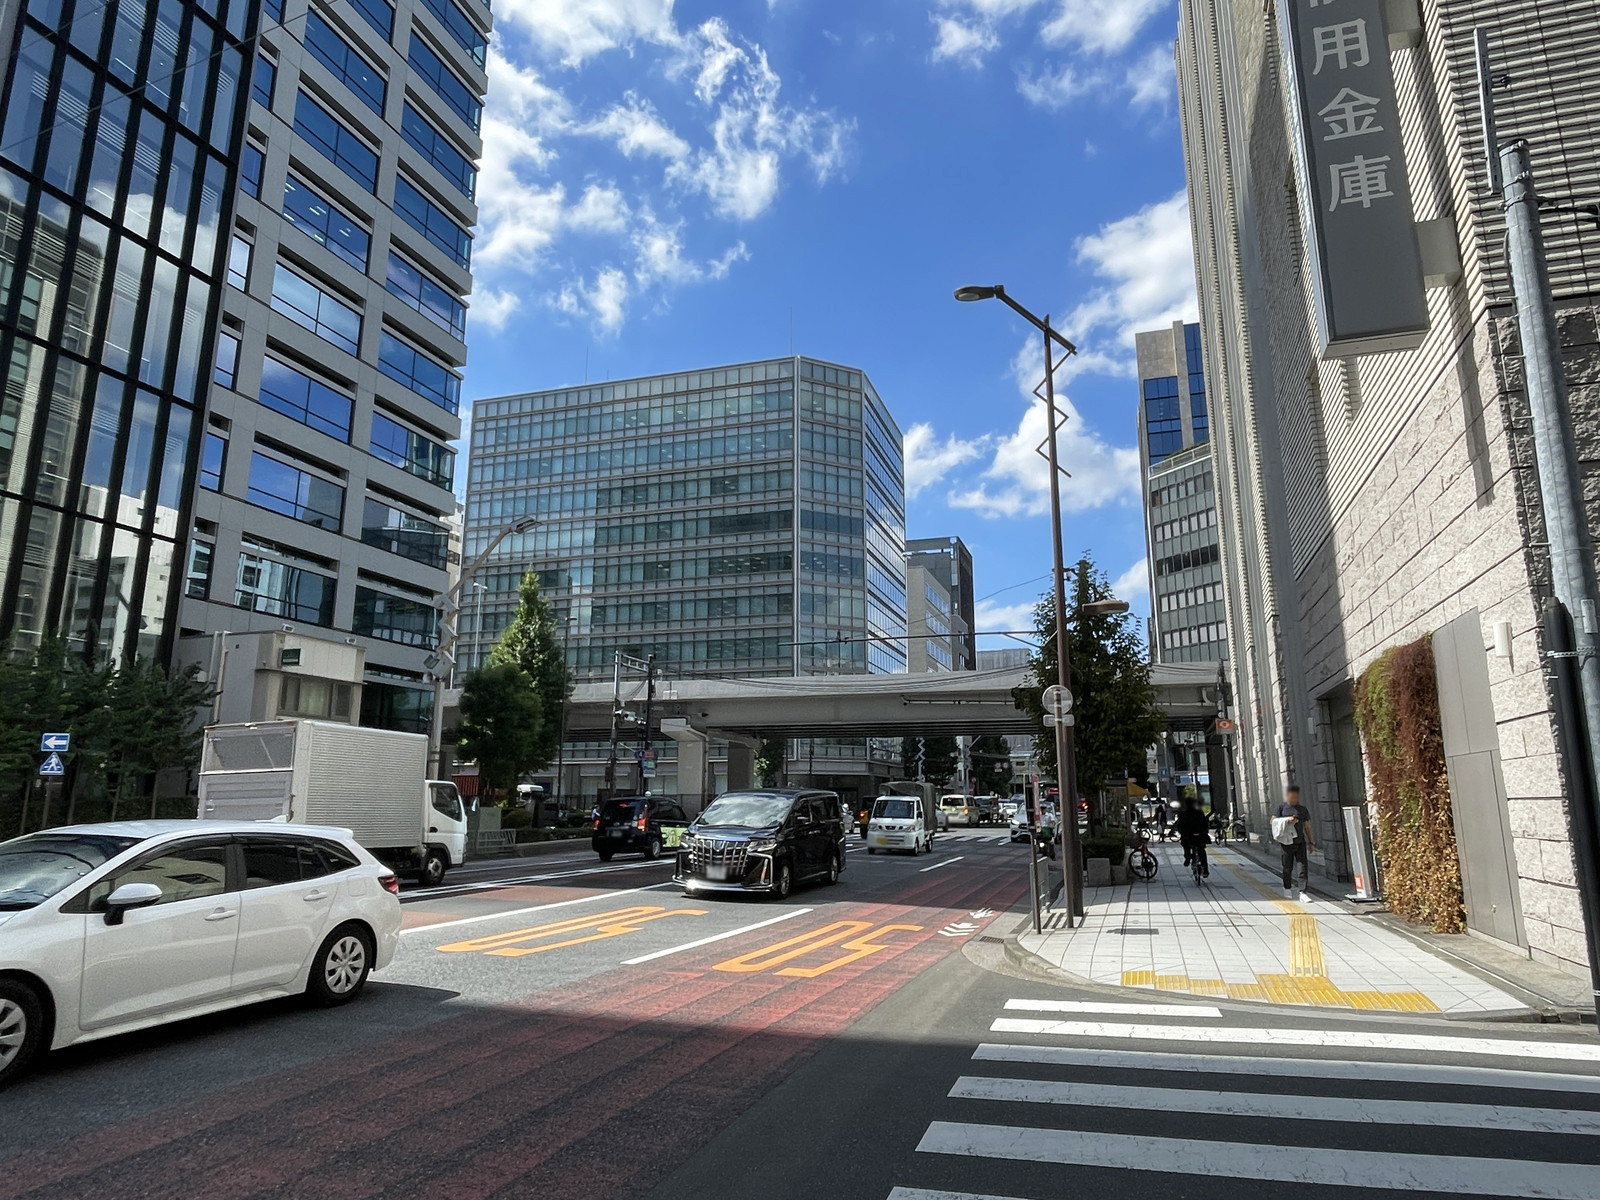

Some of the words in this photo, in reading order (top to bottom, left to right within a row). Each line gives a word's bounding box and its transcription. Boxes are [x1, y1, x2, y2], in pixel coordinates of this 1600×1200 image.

[1309, 0, 1394, 212] 用金庫
[711, 920, 925, 978] 50
